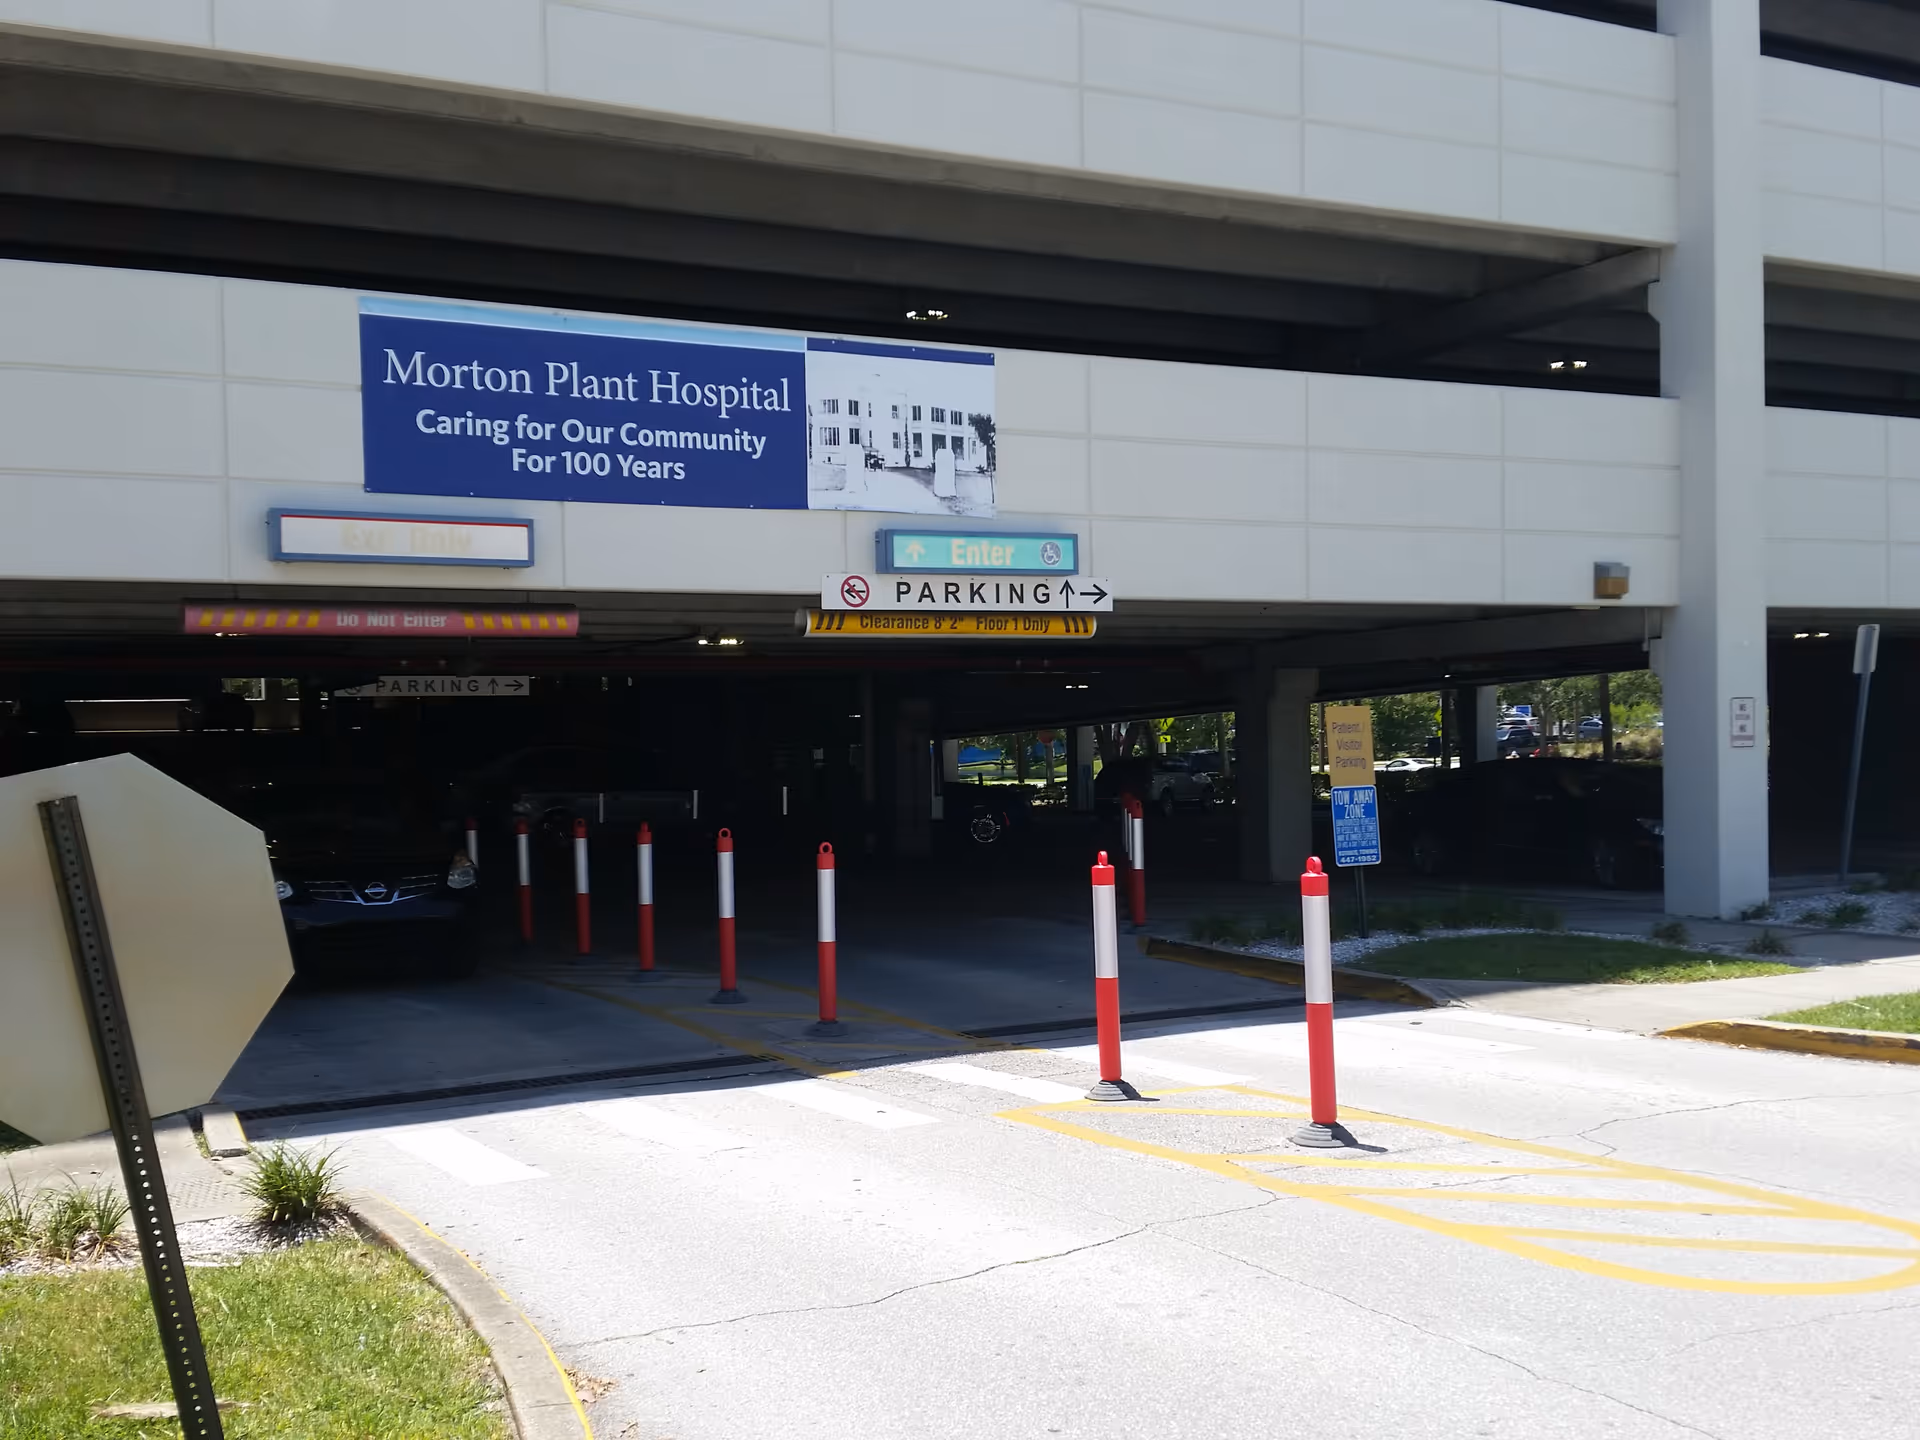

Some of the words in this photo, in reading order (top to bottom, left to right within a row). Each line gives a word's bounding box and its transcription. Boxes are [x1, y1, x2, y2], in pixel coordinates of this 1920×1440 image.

[383, 348, 534, 394] Morton
[544, 361, 639, 402] Plant
[647, 369, 792, 419] Hospital
[415, 408, 510, 445] Caring
[514, 413, 556, 441] for
[561, 418, 614, 444] Our
[619, 422, 767, 460] Community
[512, 447, 556, 473] For
[561, 450, 611, 476] 100
[616, 453, 686, 480] Years
[950, 538, 1015, 566] Enter
[895, 580, 1051, 605] PARKING
[336, 610, 359, 627] Do
[367, 610, 395, 627] Not
[403, 611, 447, 627] Enter
[859, 614, 929, 630] Clearance
[976, 616, 1009, 631] Floor
[1011, 616, 1018, 631] 1
[1023, 616, 1050, 634] Only
[375, 678, 480, 693] PARKING
[1335, 756, 1367, 770] Parking
[1333, 790, 1350, 805] TOW
[1353, 789, 1374, 804] AWAY
[1344, 804, 1366, 819] ZONE
